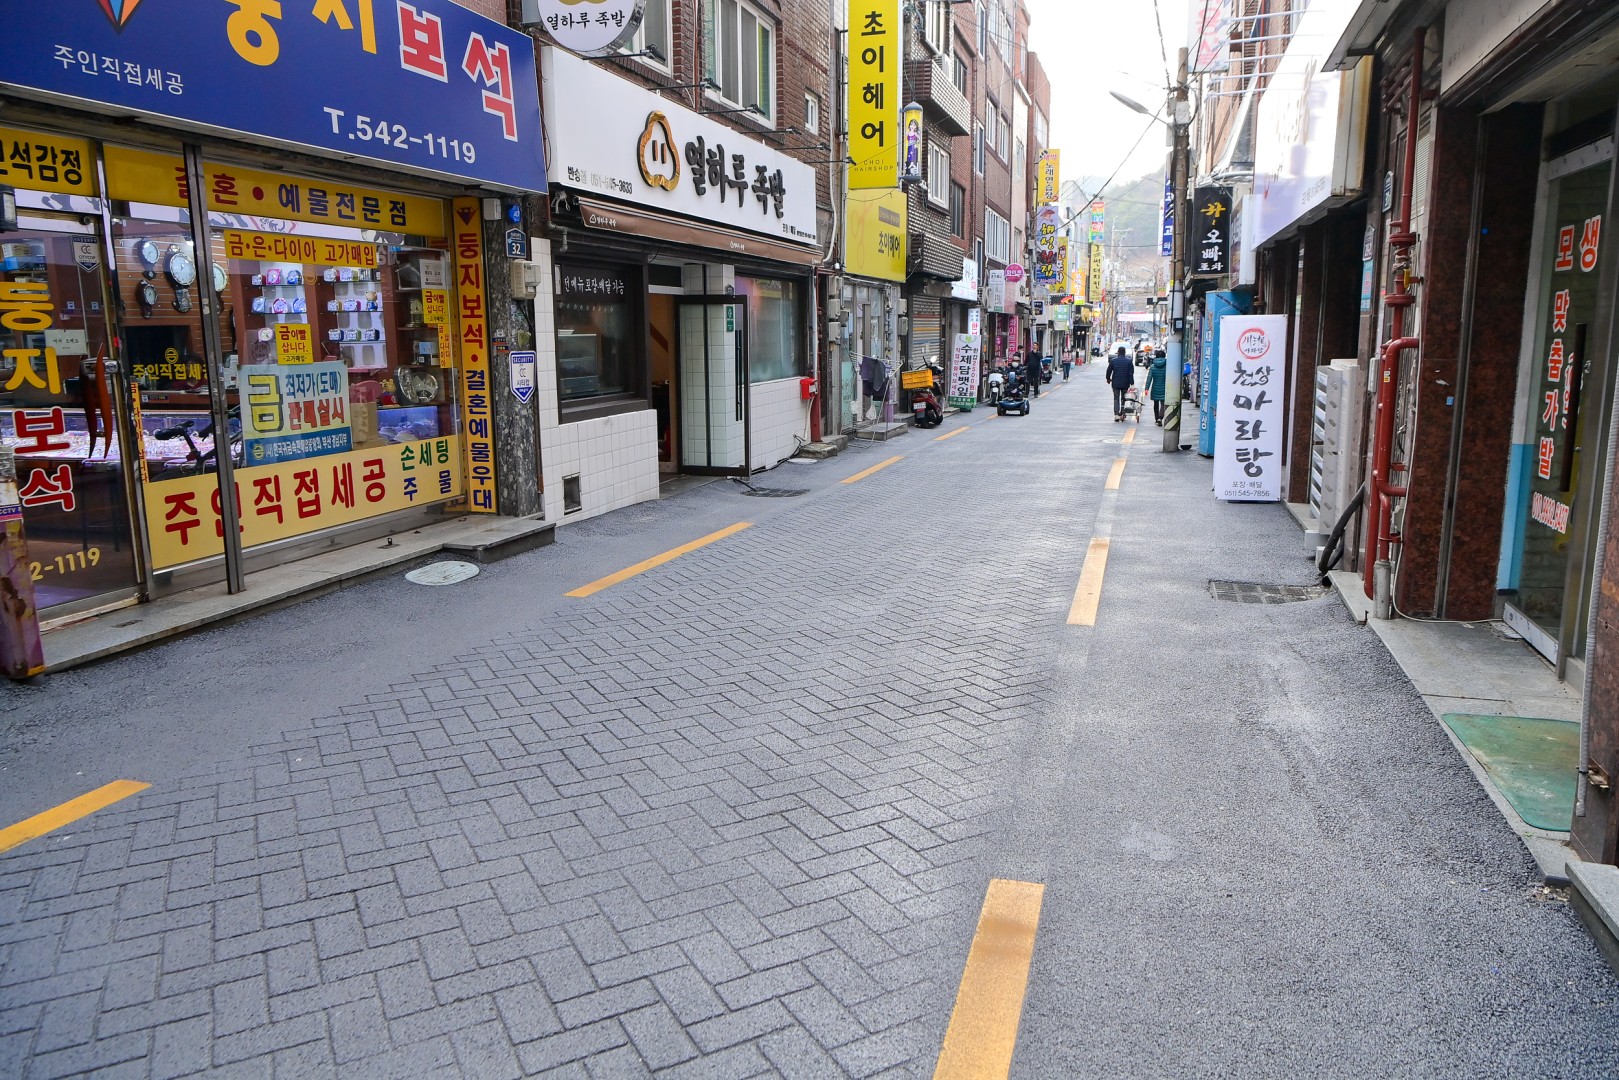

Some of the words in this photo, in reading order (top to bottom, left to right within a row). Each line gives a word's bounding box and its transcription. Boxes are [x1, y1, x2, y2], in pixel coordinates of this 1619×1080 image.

[546, 13, 590, 31] 열하루
[595, 10, 626, 28] 족발
[53, 44, 184, 95] 주인직접세공
[861, 10, 886, 148] 초이헤어
[323, 107, 476, 164] T.542-1119
[685, 136, 749, 207] 열하루
[751, 165, 786, 219] 족발
[278, 184, 407, 227] 예물전문점
[325, 243, 374, 266] 고가매입
[512, 242, 521, 255] 32
[878, 231, 901, 259] 초이헤어
[1202, 229, 1223, 261] 오빠
[458, 233, 484, 351] 둥지보석
[279, 326, 307, 341] 금이빨
[281, 342, 309, 353] 삽니다.
[247, 374, 285, 433] 금
[285, 371, 342, 399] 최저가(도매)
[1537, 289, 1570, 479] 맞춤가발
[288, 396, 345, 431] 판매실시
[1232, 390, 1274, 478] 마라탕
[401, 438, 450, 471] 손세팅
[465, 369, 493, 509] 결혼예물우대
[164, 458, 386, 545] 주인직접세공
